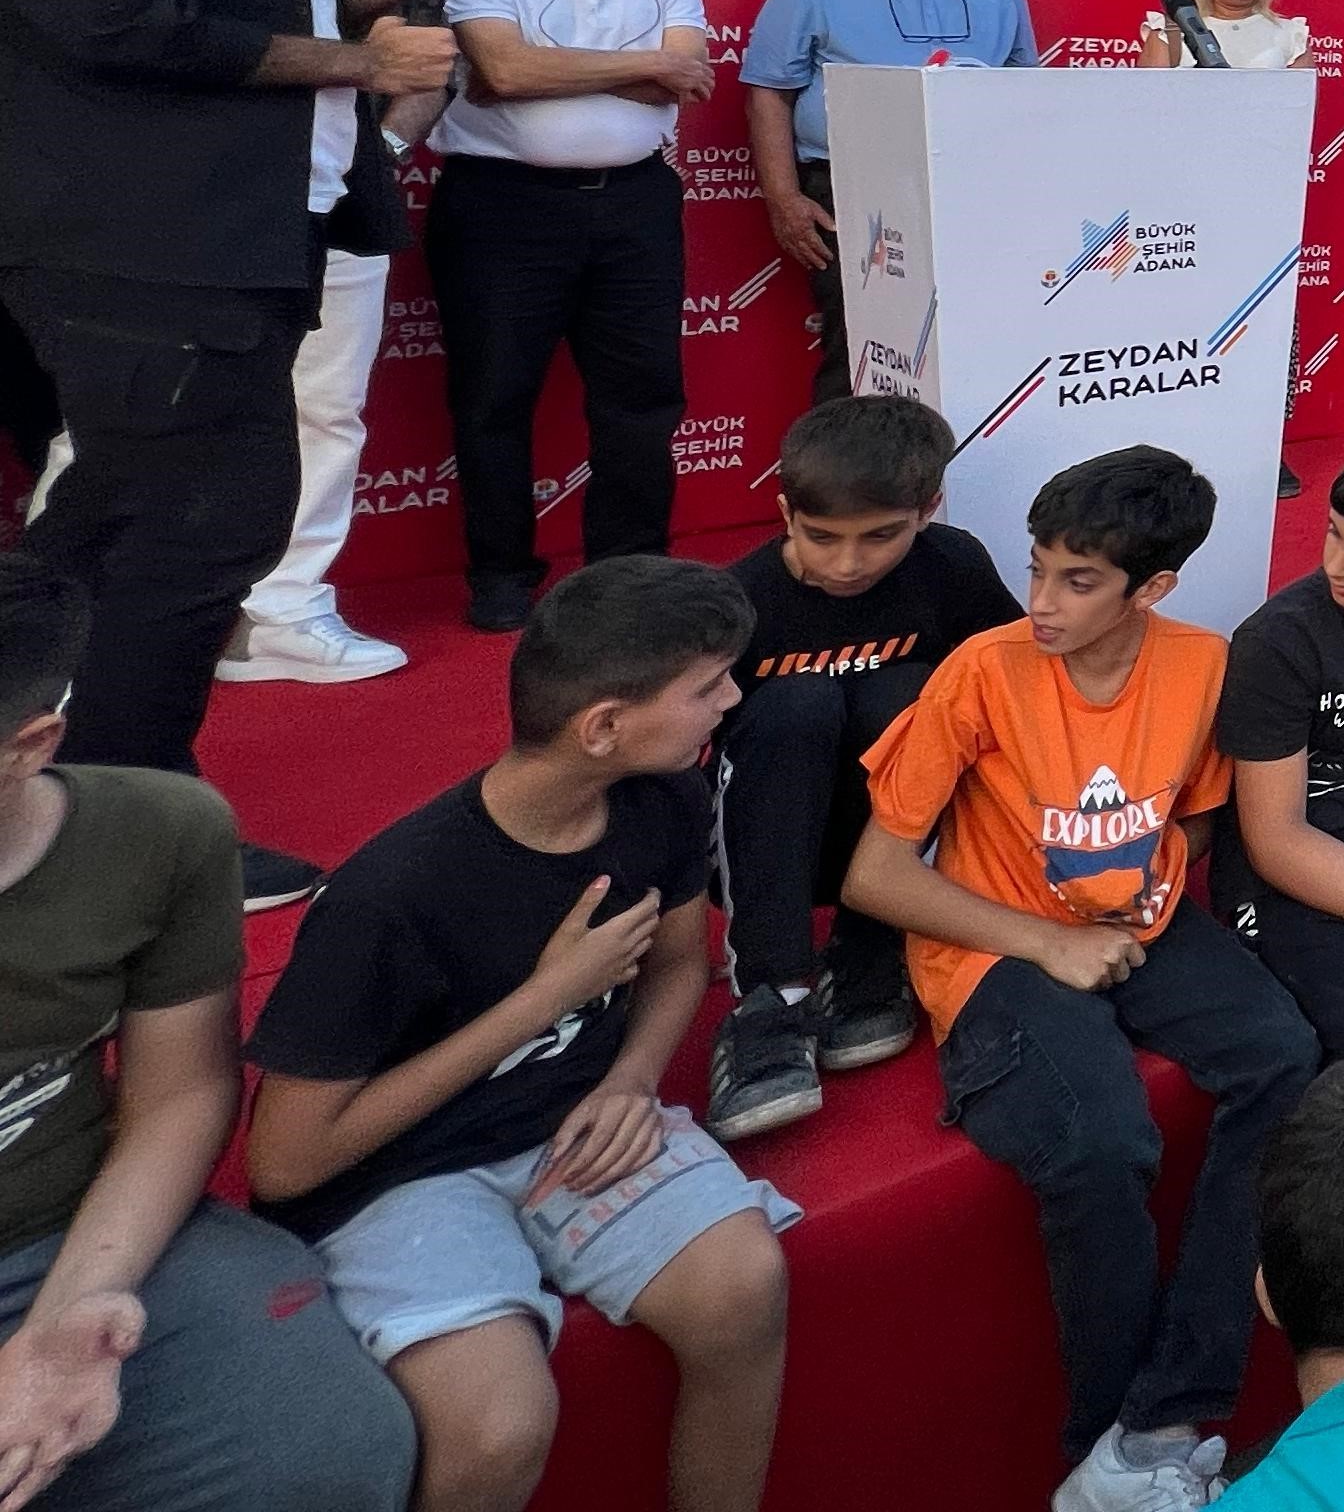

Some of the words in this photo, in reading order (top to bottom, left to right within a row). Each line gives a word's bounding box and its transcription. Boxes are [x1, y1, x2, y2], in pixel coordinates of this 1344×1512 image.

[1069, 37, 1143, 54] ZEYDA
[686, 146, 750, 163] BÜYÜ
[682, 186, 764, 201] ADANA
[1136, 223, 1196, 239] BÜYÜK
[1142, 240, 1195, 260] ŞEHİR
[1133, 256, 1196, 274] ADANA
[1298, 259, 1330, 273] EHİR
[870, 340, 912, 377] ZEYDAN
[1058, 338, 1199, 377] ZEYDAN
[1058, 364, 1222, 408] KARALAR
[671, 434, 744, 461] ŞEHİR
[1042, 796, 1165, 848] EXPLORE
